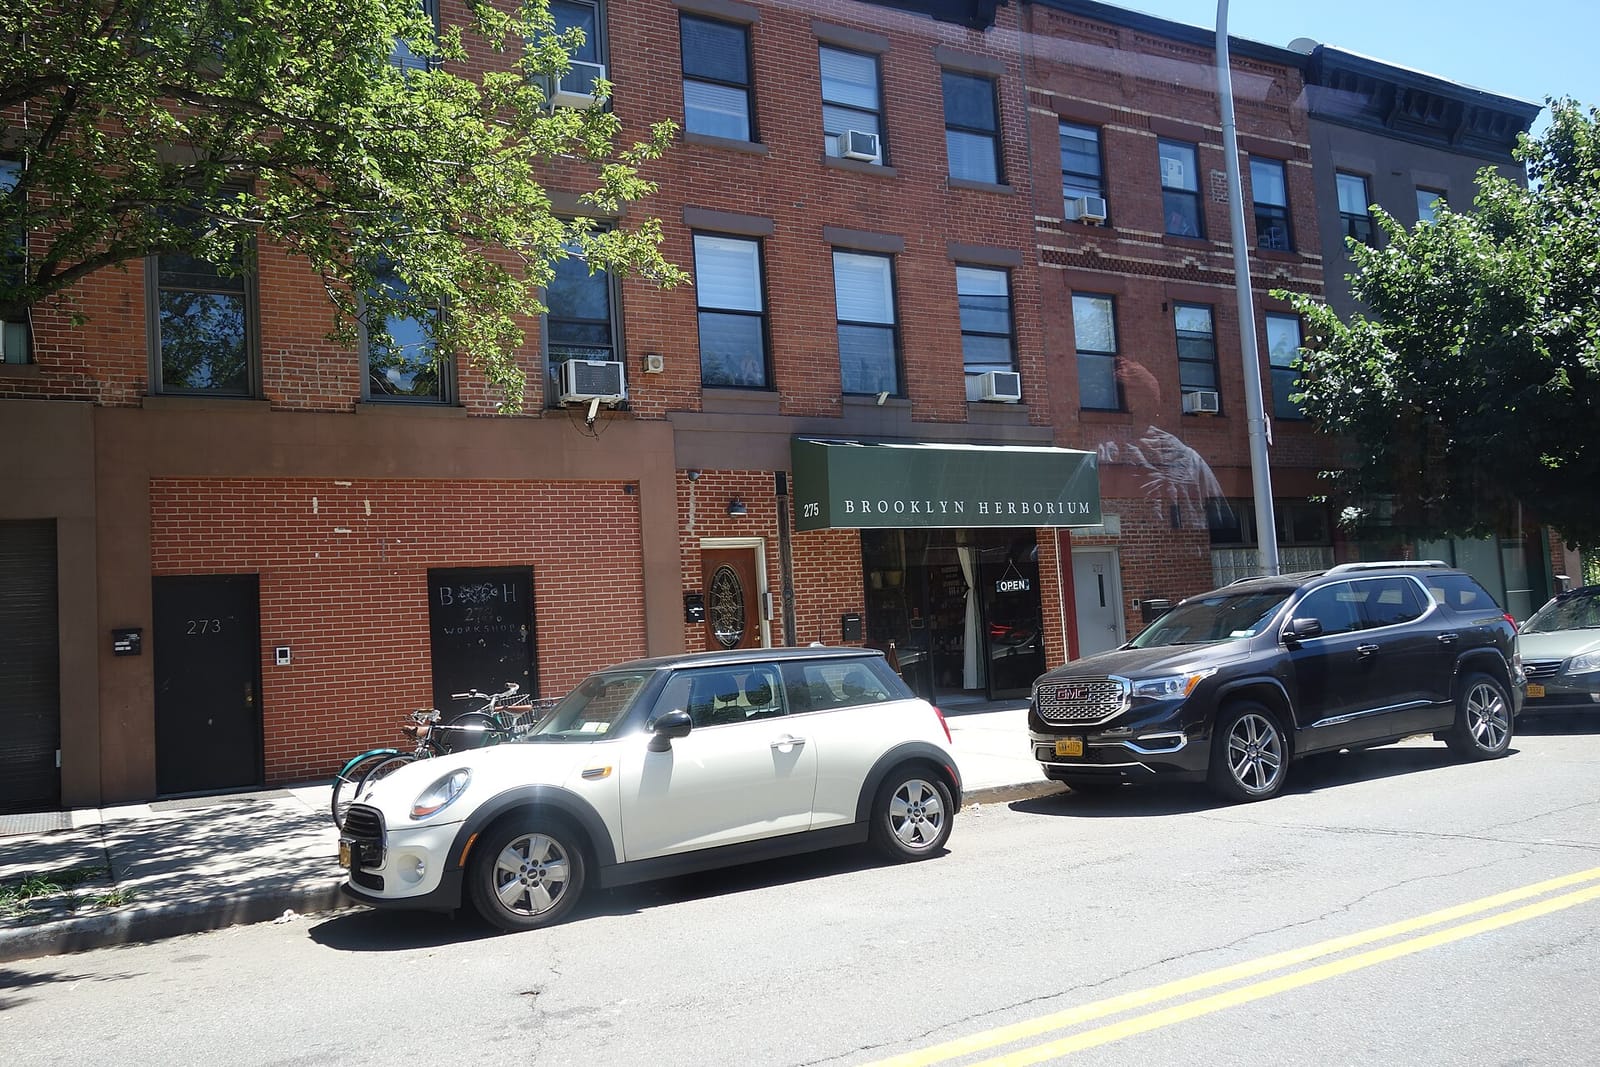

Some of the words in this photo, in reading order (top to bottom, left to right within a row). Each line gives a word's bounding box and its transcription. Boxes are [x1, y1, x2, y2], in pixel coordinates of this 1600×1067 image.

[803, 502, 820, 518] 275
[845, 500, 965, 514] BROOKLYN
[978, 502, 1090, 515] HERBORIUM
[1000, 580, 1025, 591] OPEN
[187, 620, 221, 634] 273
[1057, 689, 1088, 700] GMC
